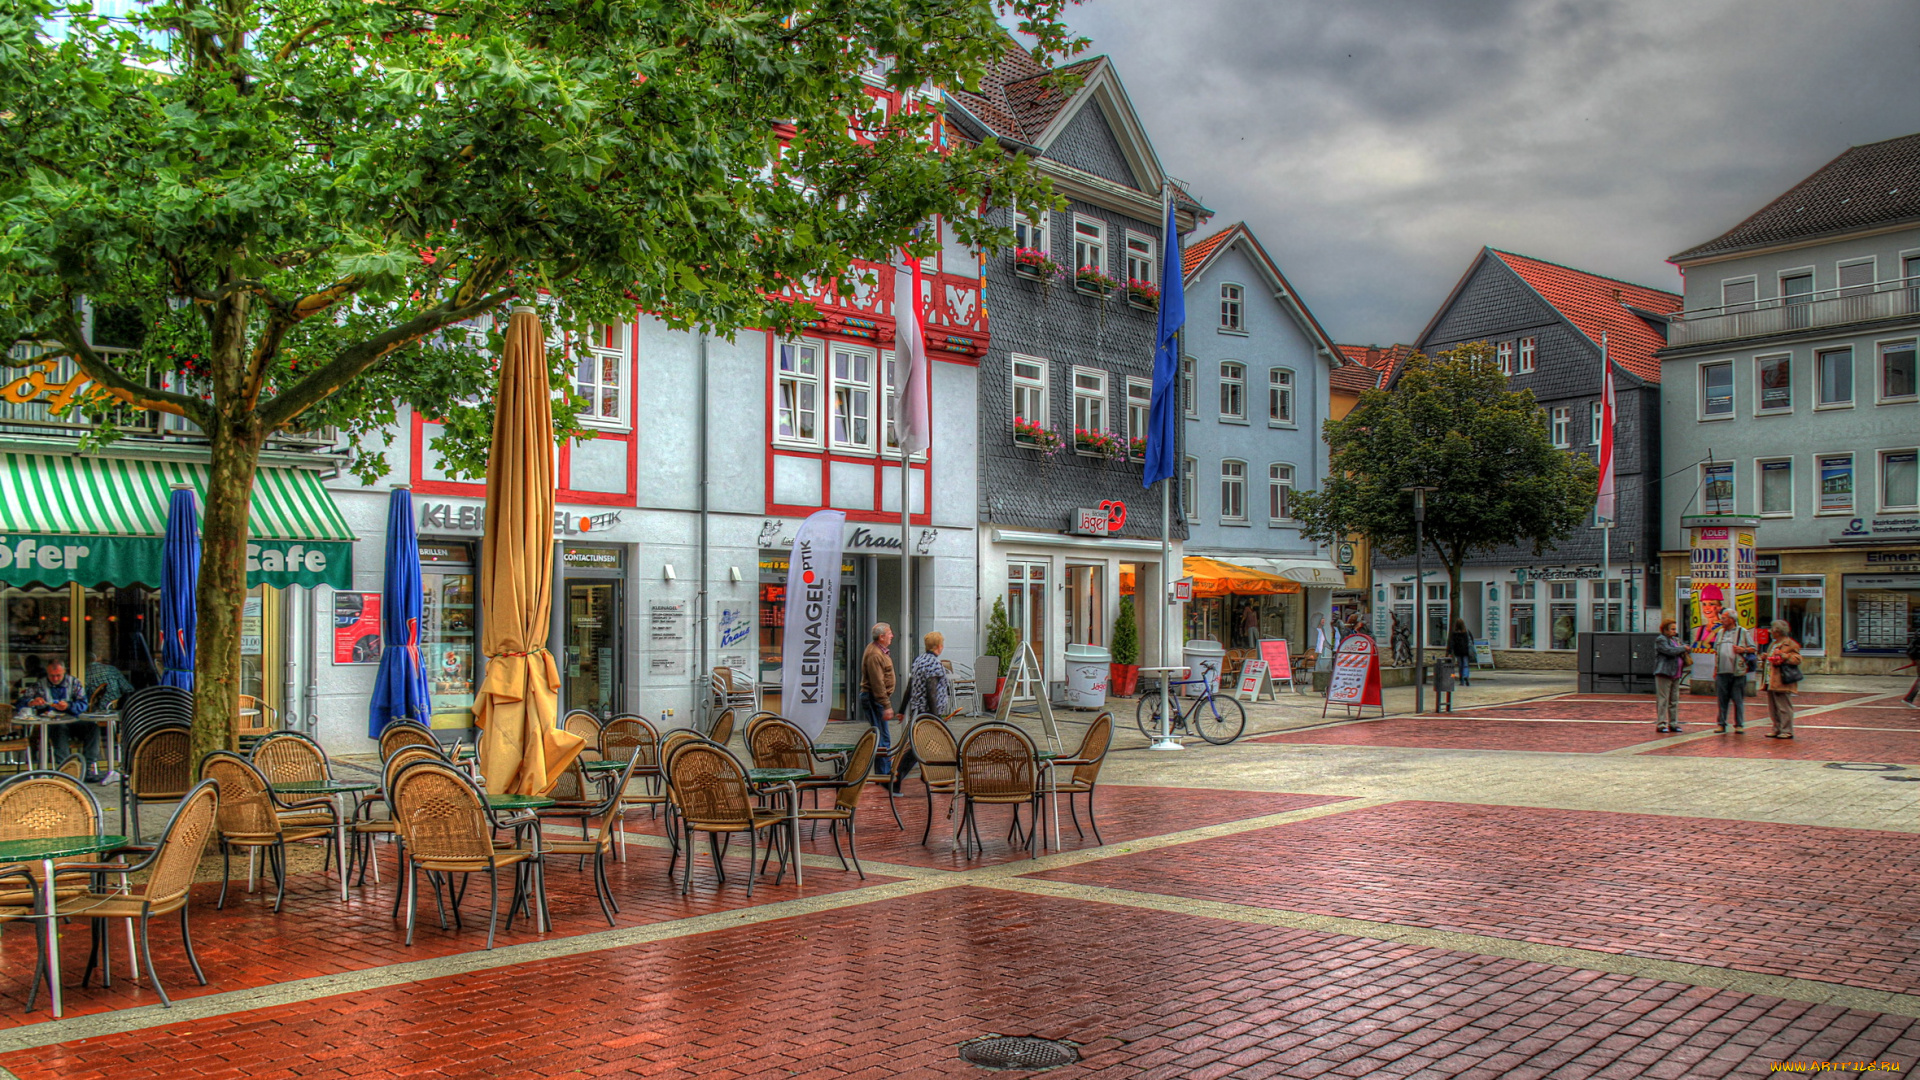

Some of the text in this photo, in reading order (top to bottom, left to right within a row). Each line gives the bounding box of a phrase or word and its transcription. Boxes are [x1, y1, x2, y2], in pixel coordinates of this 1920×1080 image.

[1079, 513, 1107, 533] Jäger
[419, 548, 448, 556] BRILLEN
[563, 553, 616, 562] CONTACTLINSEN
[801, 578, 824, 703] KLEINAGEL
